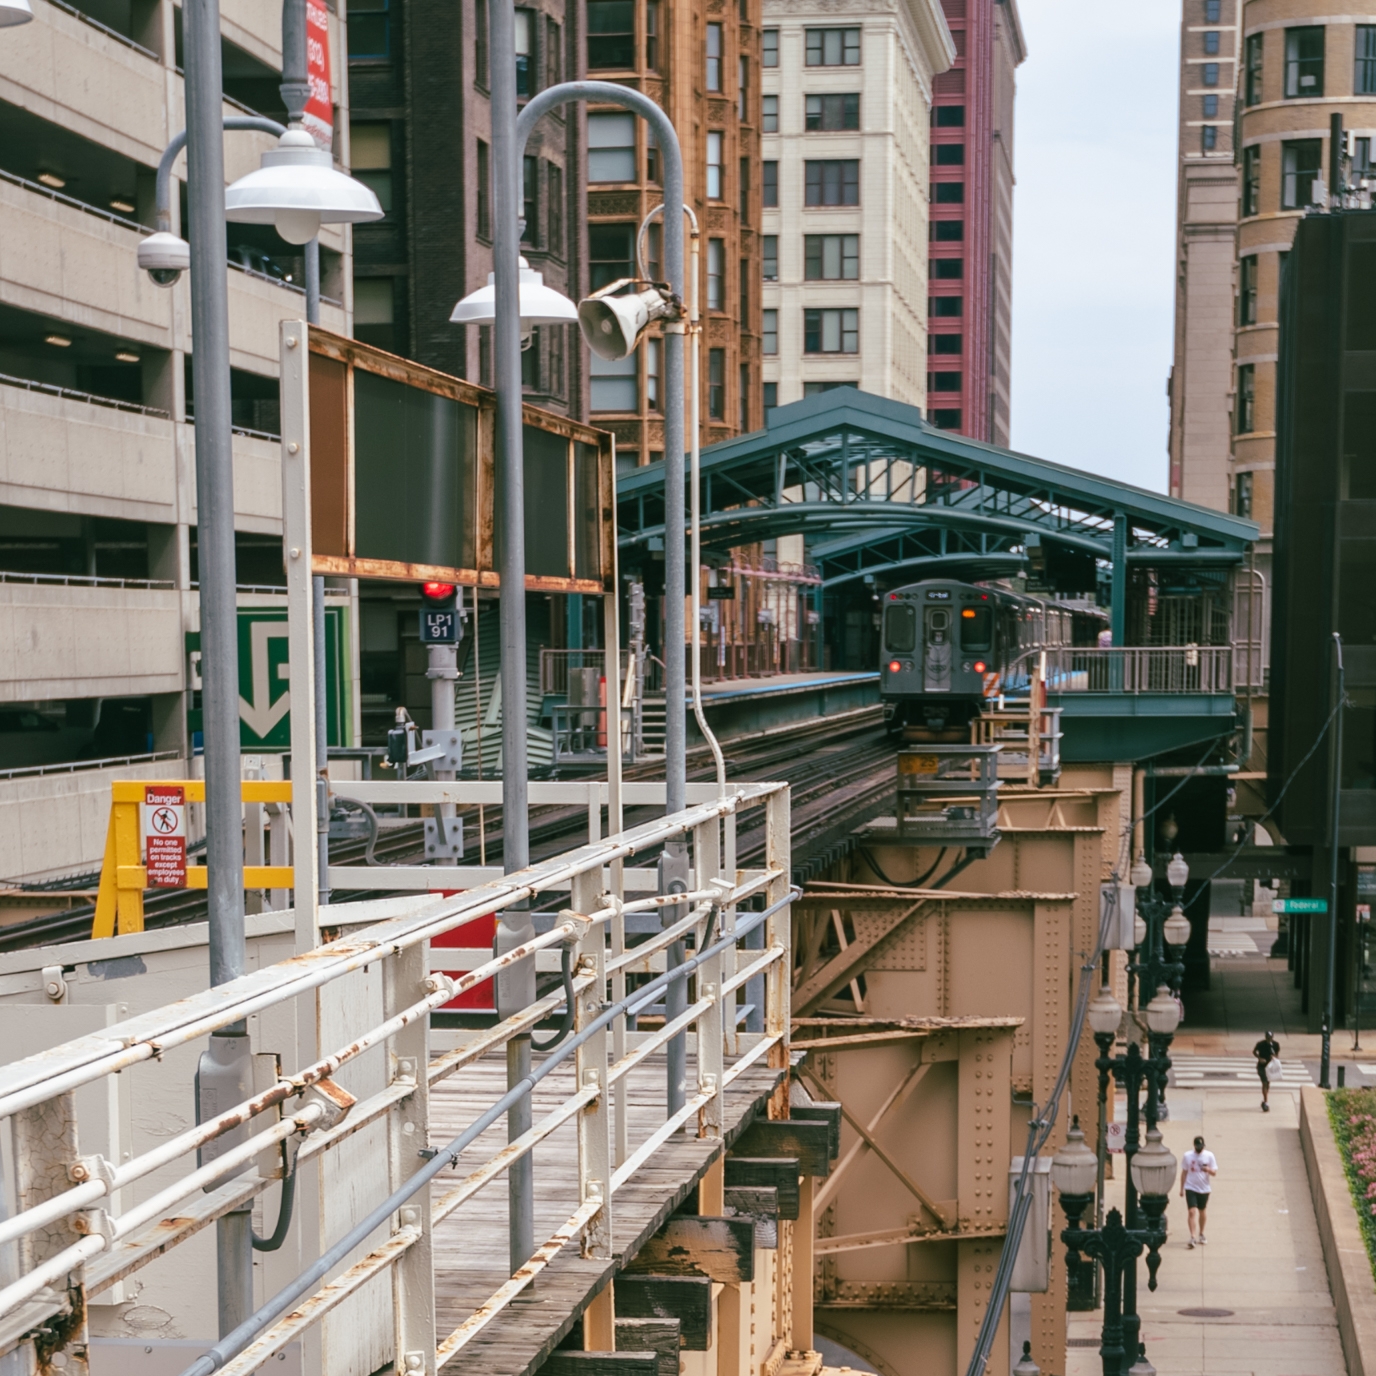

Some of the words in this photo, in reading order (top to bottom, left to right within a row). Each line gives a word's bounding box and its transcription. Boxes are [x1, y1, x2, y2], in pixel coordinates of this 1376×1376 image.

[427, 614, 452, 626] LP1
[431, 625, 447, 637] 91
[147, 794, 181, 806] Danger
[149, 846, 182, 854] permitted
[160, 853, 181, 861] tracks
[154, 861, 177, 869] except
[148, 868, 184, 876] employees
[164, 876, 179, 884] duty
[1289, 900, 1319, 910] Federal
